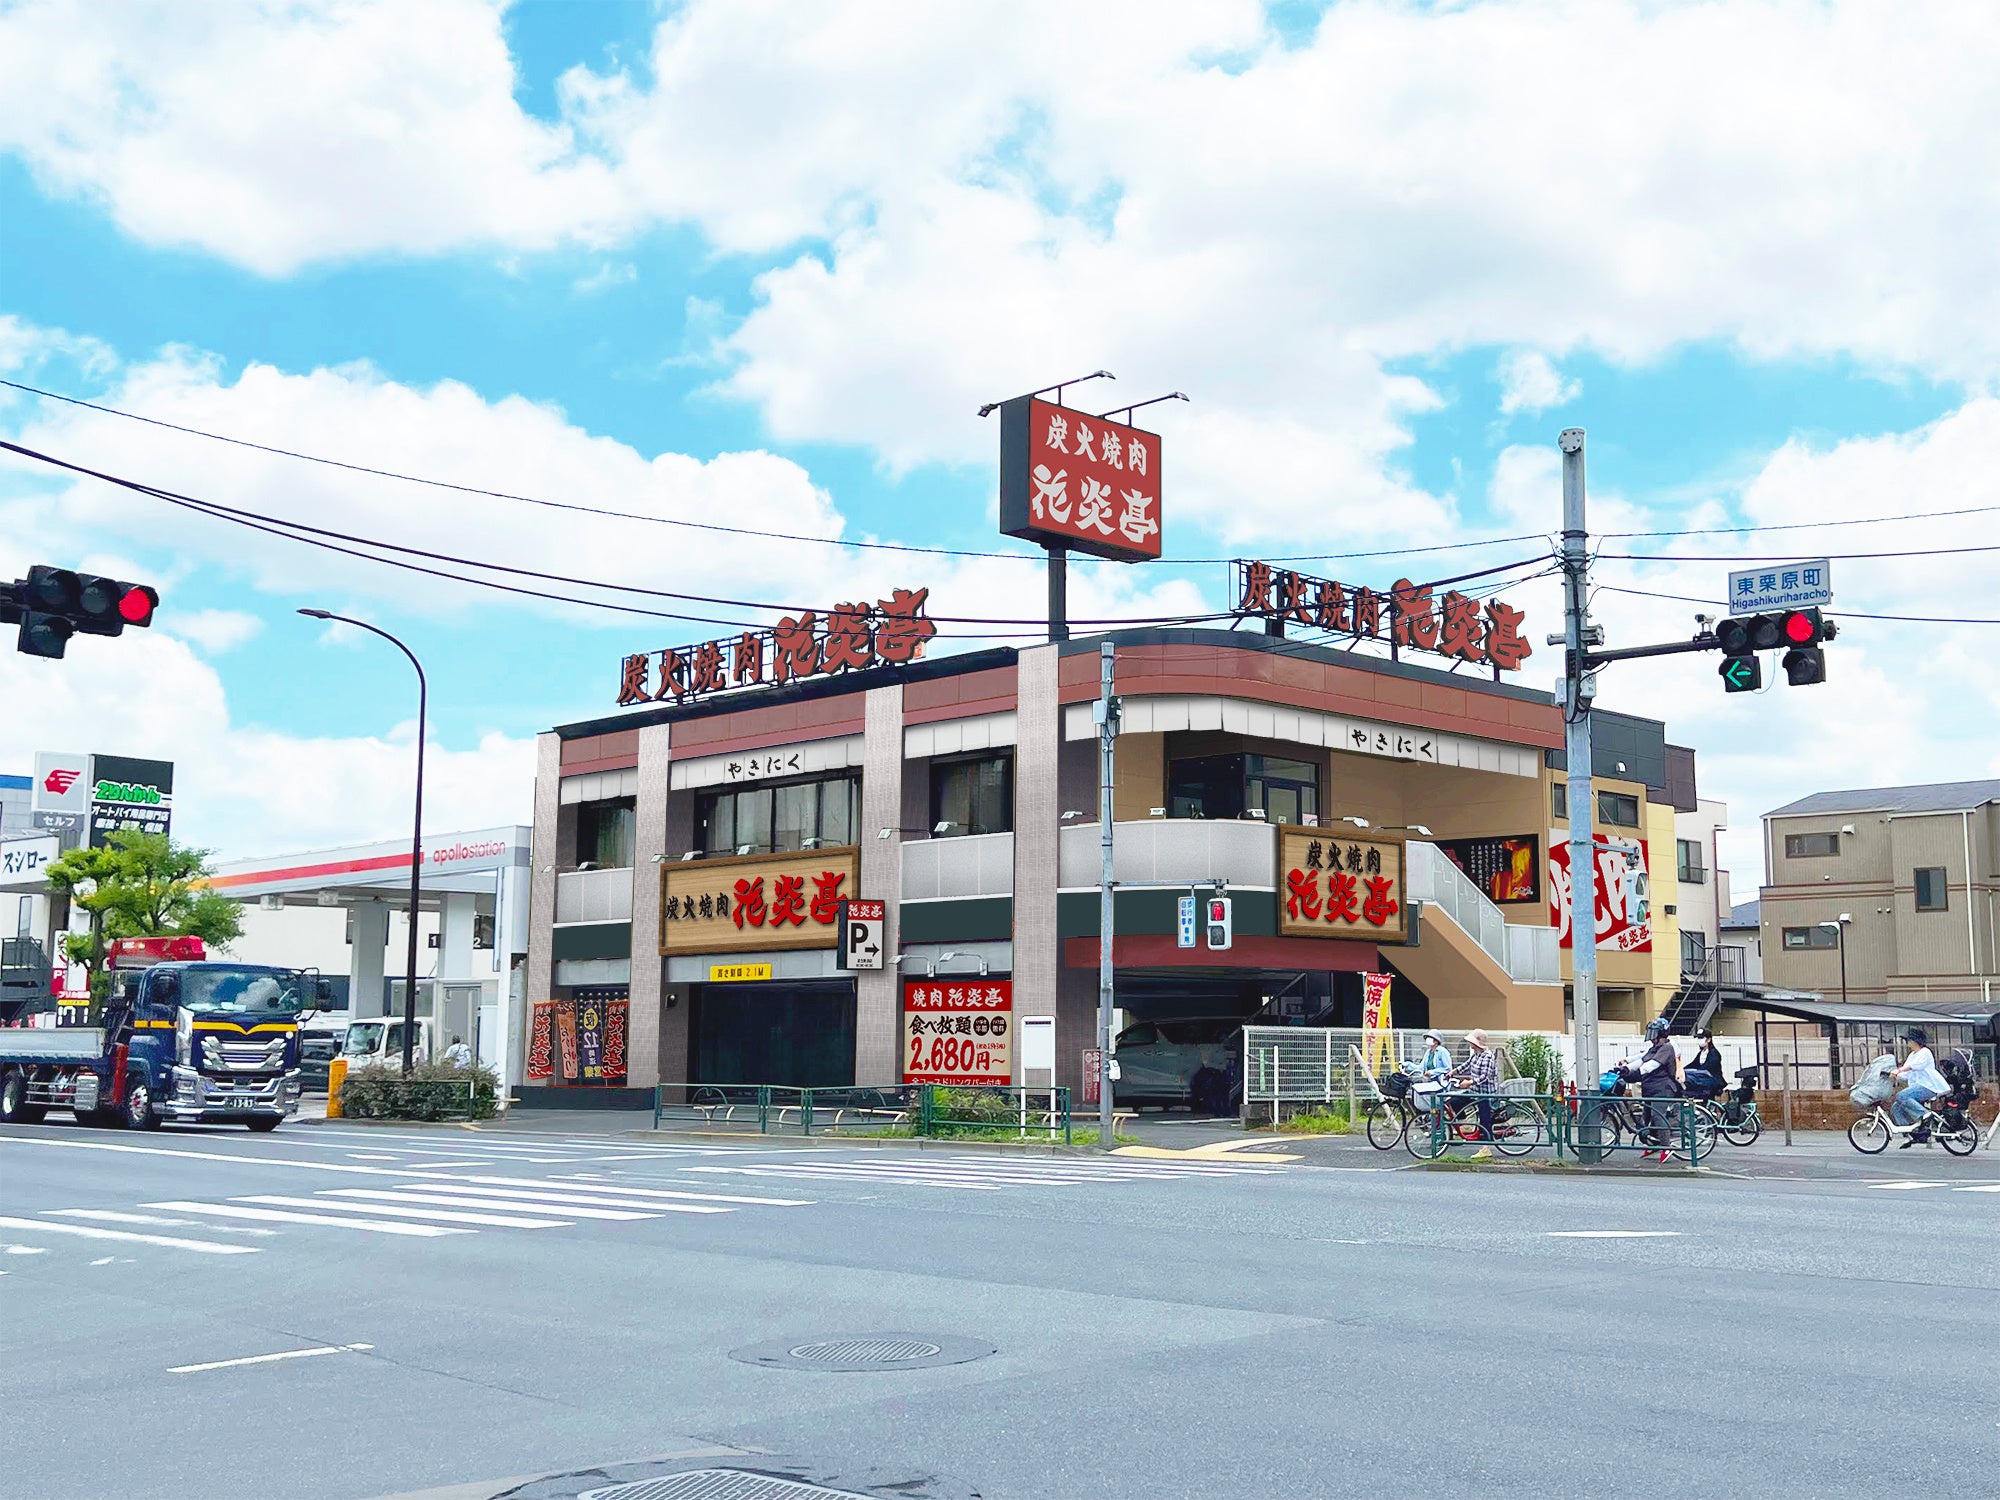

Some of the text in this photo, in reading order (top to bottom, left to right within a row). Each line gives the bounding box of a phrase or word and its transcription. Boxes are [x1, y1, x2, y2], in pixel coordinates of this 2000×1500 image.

[1045, 413, 1148, 477] 炭火焼肉
[1032, 463, 1159, 544] 花炎亭
[1737, 568, 1822, 596] 東栗原町
[1241, 560, 1380, 639] 炭火焼肉
[1732, 588, 1828, 610] Higashikuriharacho
[773, 587, 937, 684] 花炎亭
[1390, 578, 1533, 671] 花炎亭
[616, 631, 762, 704] 炭火焼肉
[1351, 728, 1433, 759] やきにく
[728, 753, 801, 779] やきにく
[43, 815, 75, 827] セルフ
[3, 850, 48, 874] スシロー
[434, 841, 505, 867] apollostation
[1307, 839, 1381, 874] 炭火焼肉
[664, 892, 730, 920] 炭火焼肉
[732, 871, 847, 930] 花炎亭
[848, 904, 882, 918] 花炎亭
[1287, 868, 1399, 926] 花炎亭
[430, 935, 437, 947] 1
[472, 936, 481, 948] 2
[851, 922, 869, 954] P
[1617, 924, 1650, 950] 花炎亭
[912, 987, 1004, 1008] 焼肉 花炎亭
[909, 1014, 972, 1036] 食べ放題
